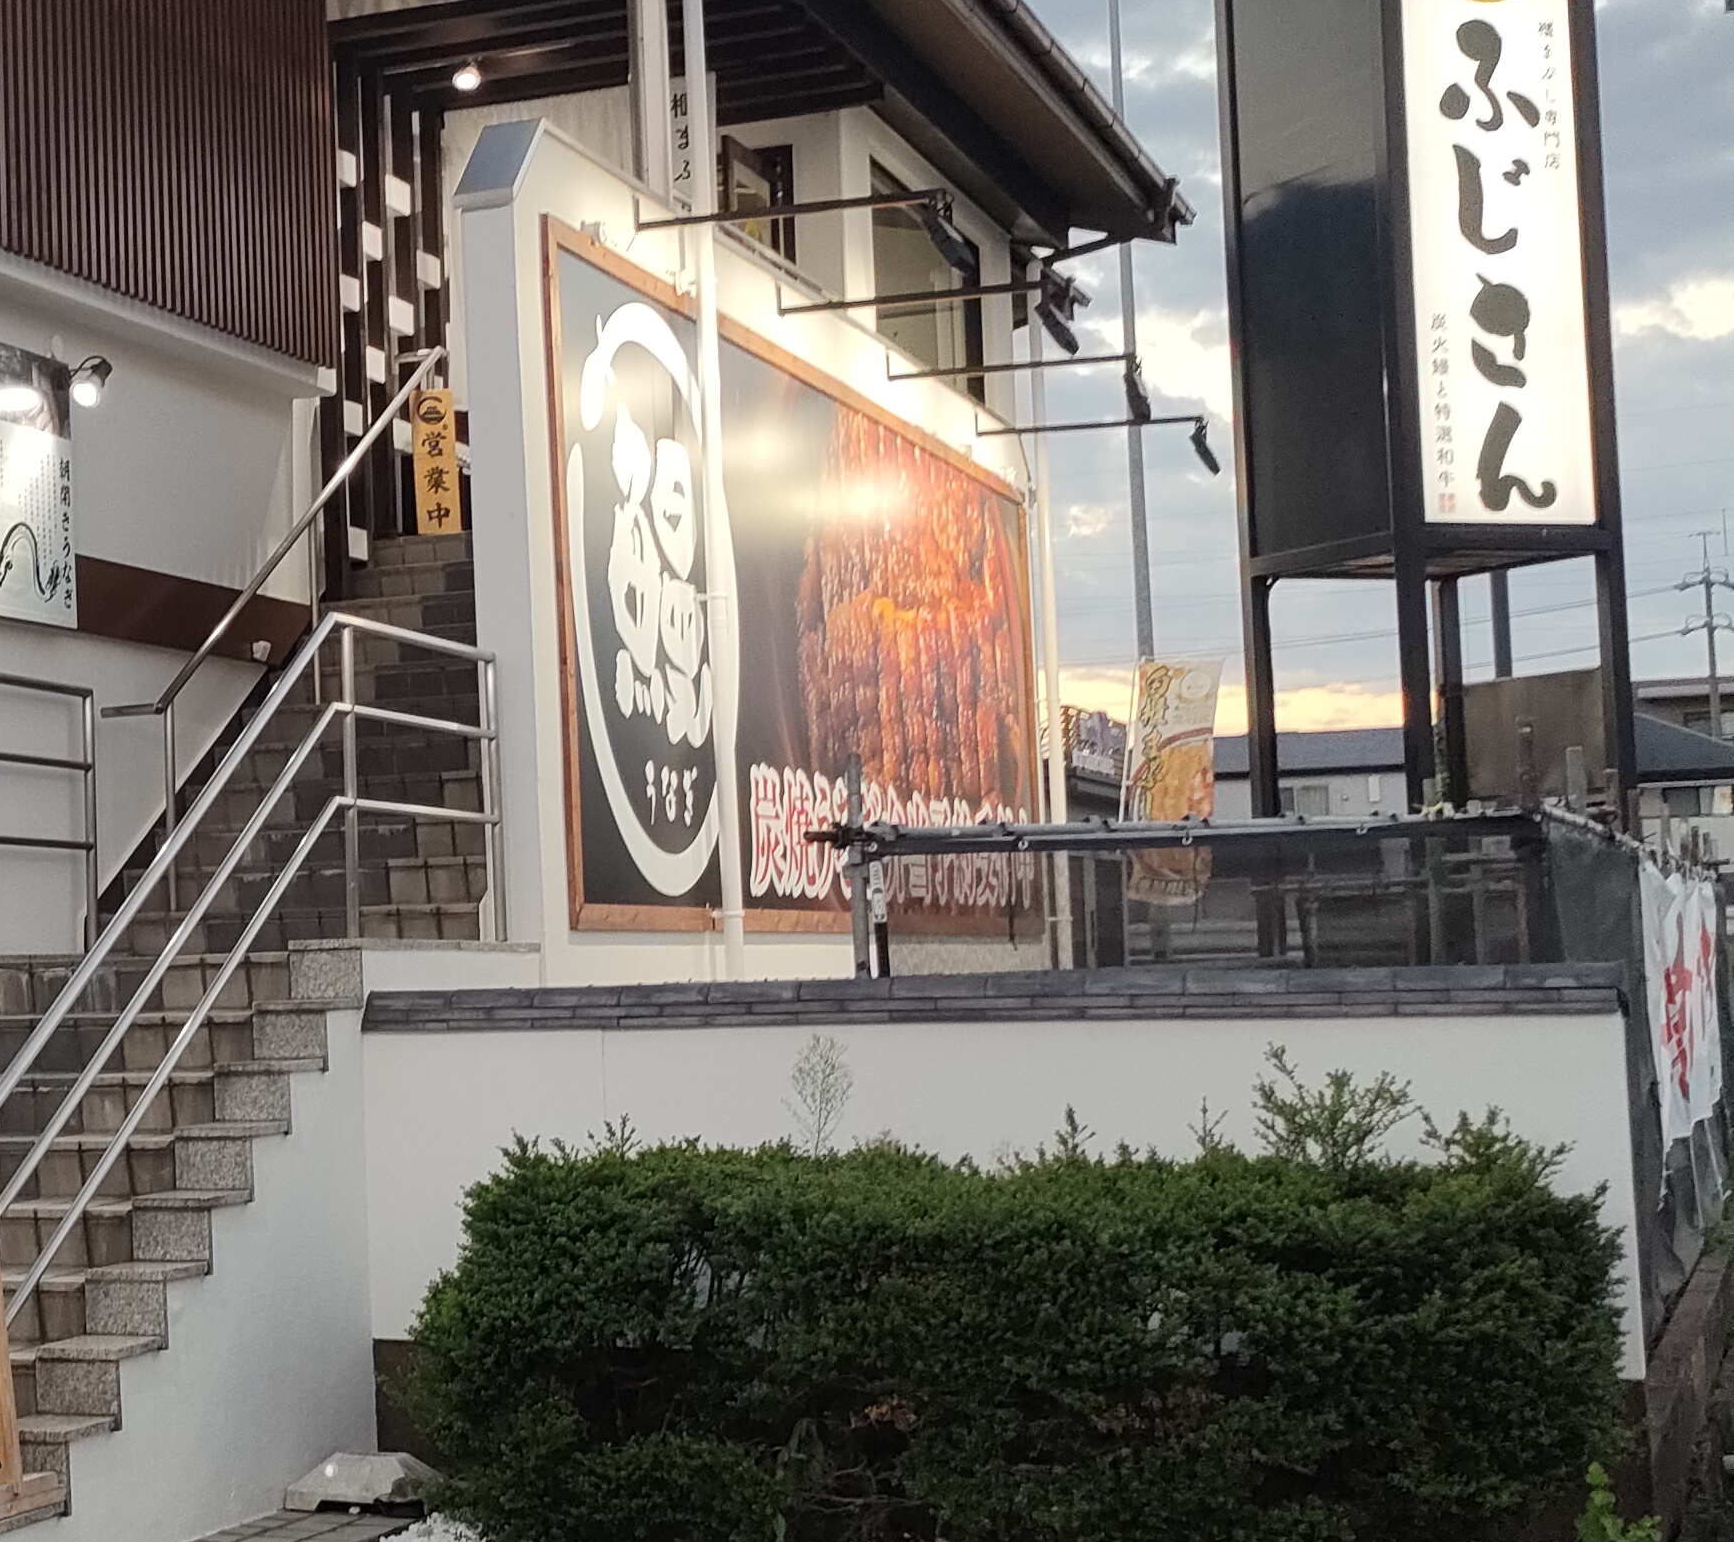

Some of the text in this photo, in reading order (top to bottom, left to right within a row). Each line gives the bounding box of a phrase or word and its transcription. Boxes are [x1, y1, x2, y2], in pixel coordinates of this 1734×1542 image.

[1439, 19, 1558, 512] ふじさん
[420, 430, 451, 529] 営業中
[646, 759, 698, 827] うなぎ
